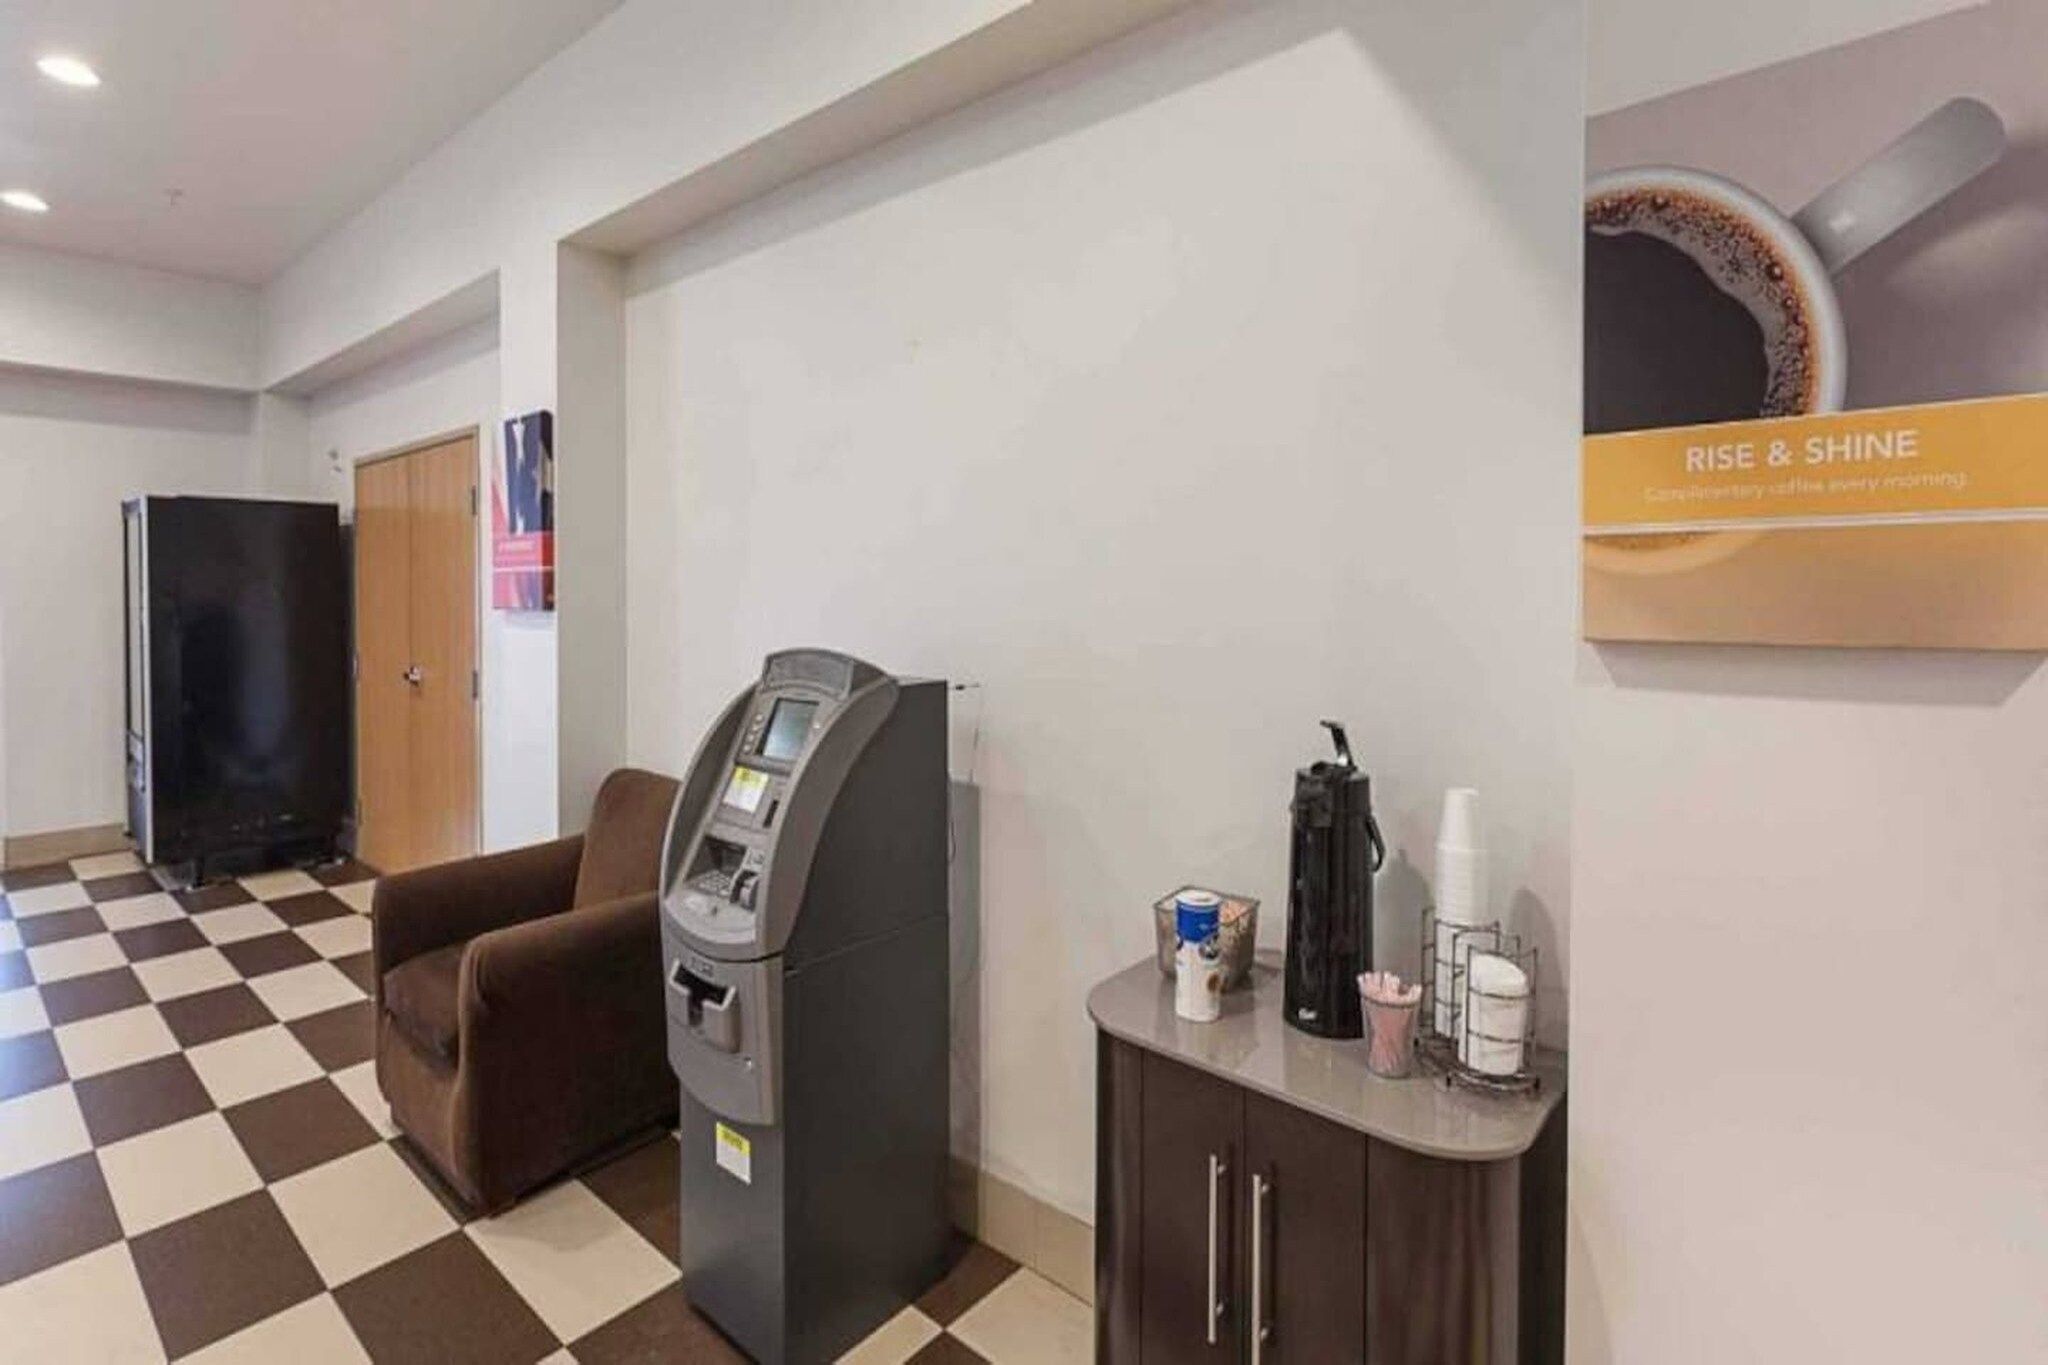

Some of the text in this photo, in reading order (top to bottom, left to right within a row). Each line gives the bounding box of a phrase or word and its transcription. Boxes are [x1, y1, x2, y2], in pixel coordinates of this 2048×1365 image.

[1686, 429, 1919, 472] RISE & SHINE
